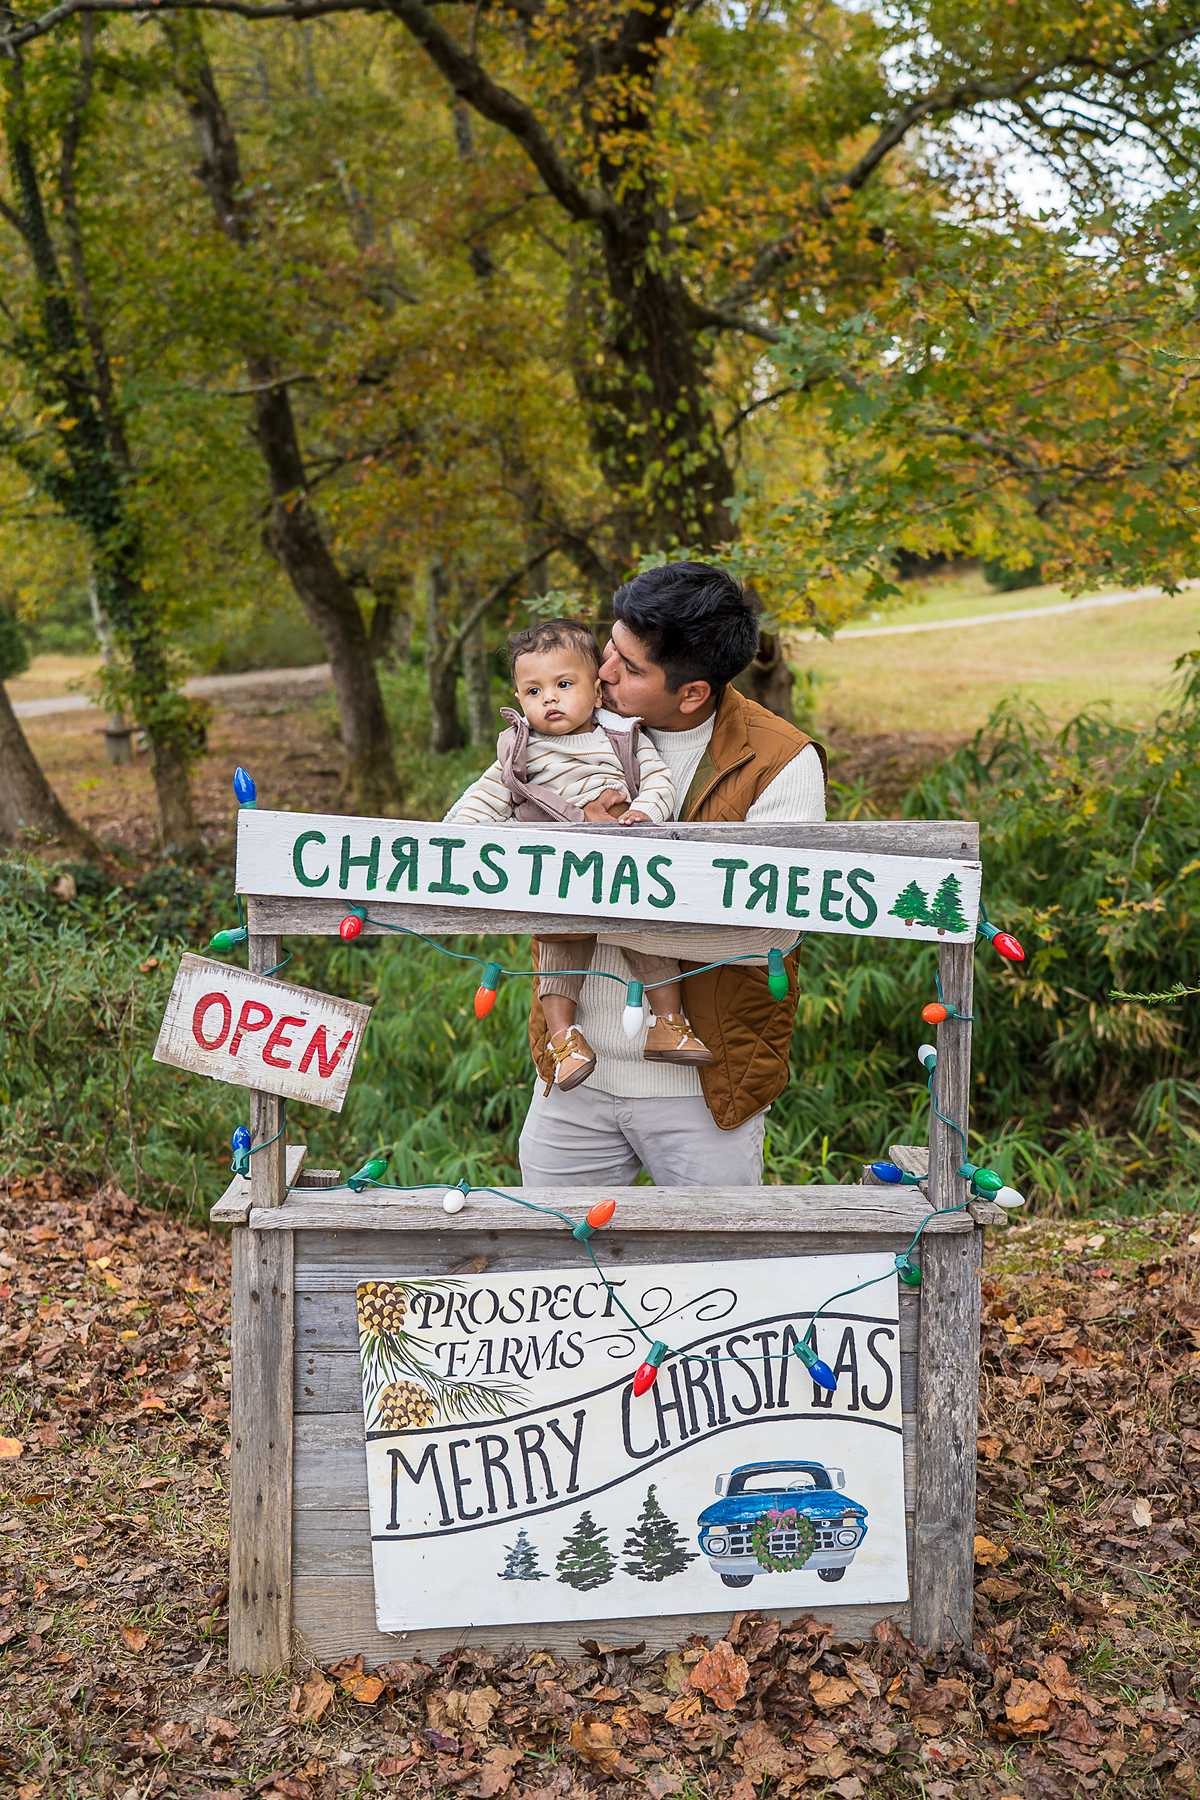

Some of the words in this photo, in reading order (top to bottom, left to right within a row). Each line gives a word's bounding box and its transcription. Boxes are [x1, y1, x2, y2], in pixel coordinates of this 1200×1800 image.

[192, 991, 354, 1079] OPEN
[410, 1279, 627, 1334] PROSPECT
[434, 1330, 585, 1380] FARMS
[385, 1409, 586, 1530] MERRY
[621, 1323, 895, 1459] CHRISTMAS
